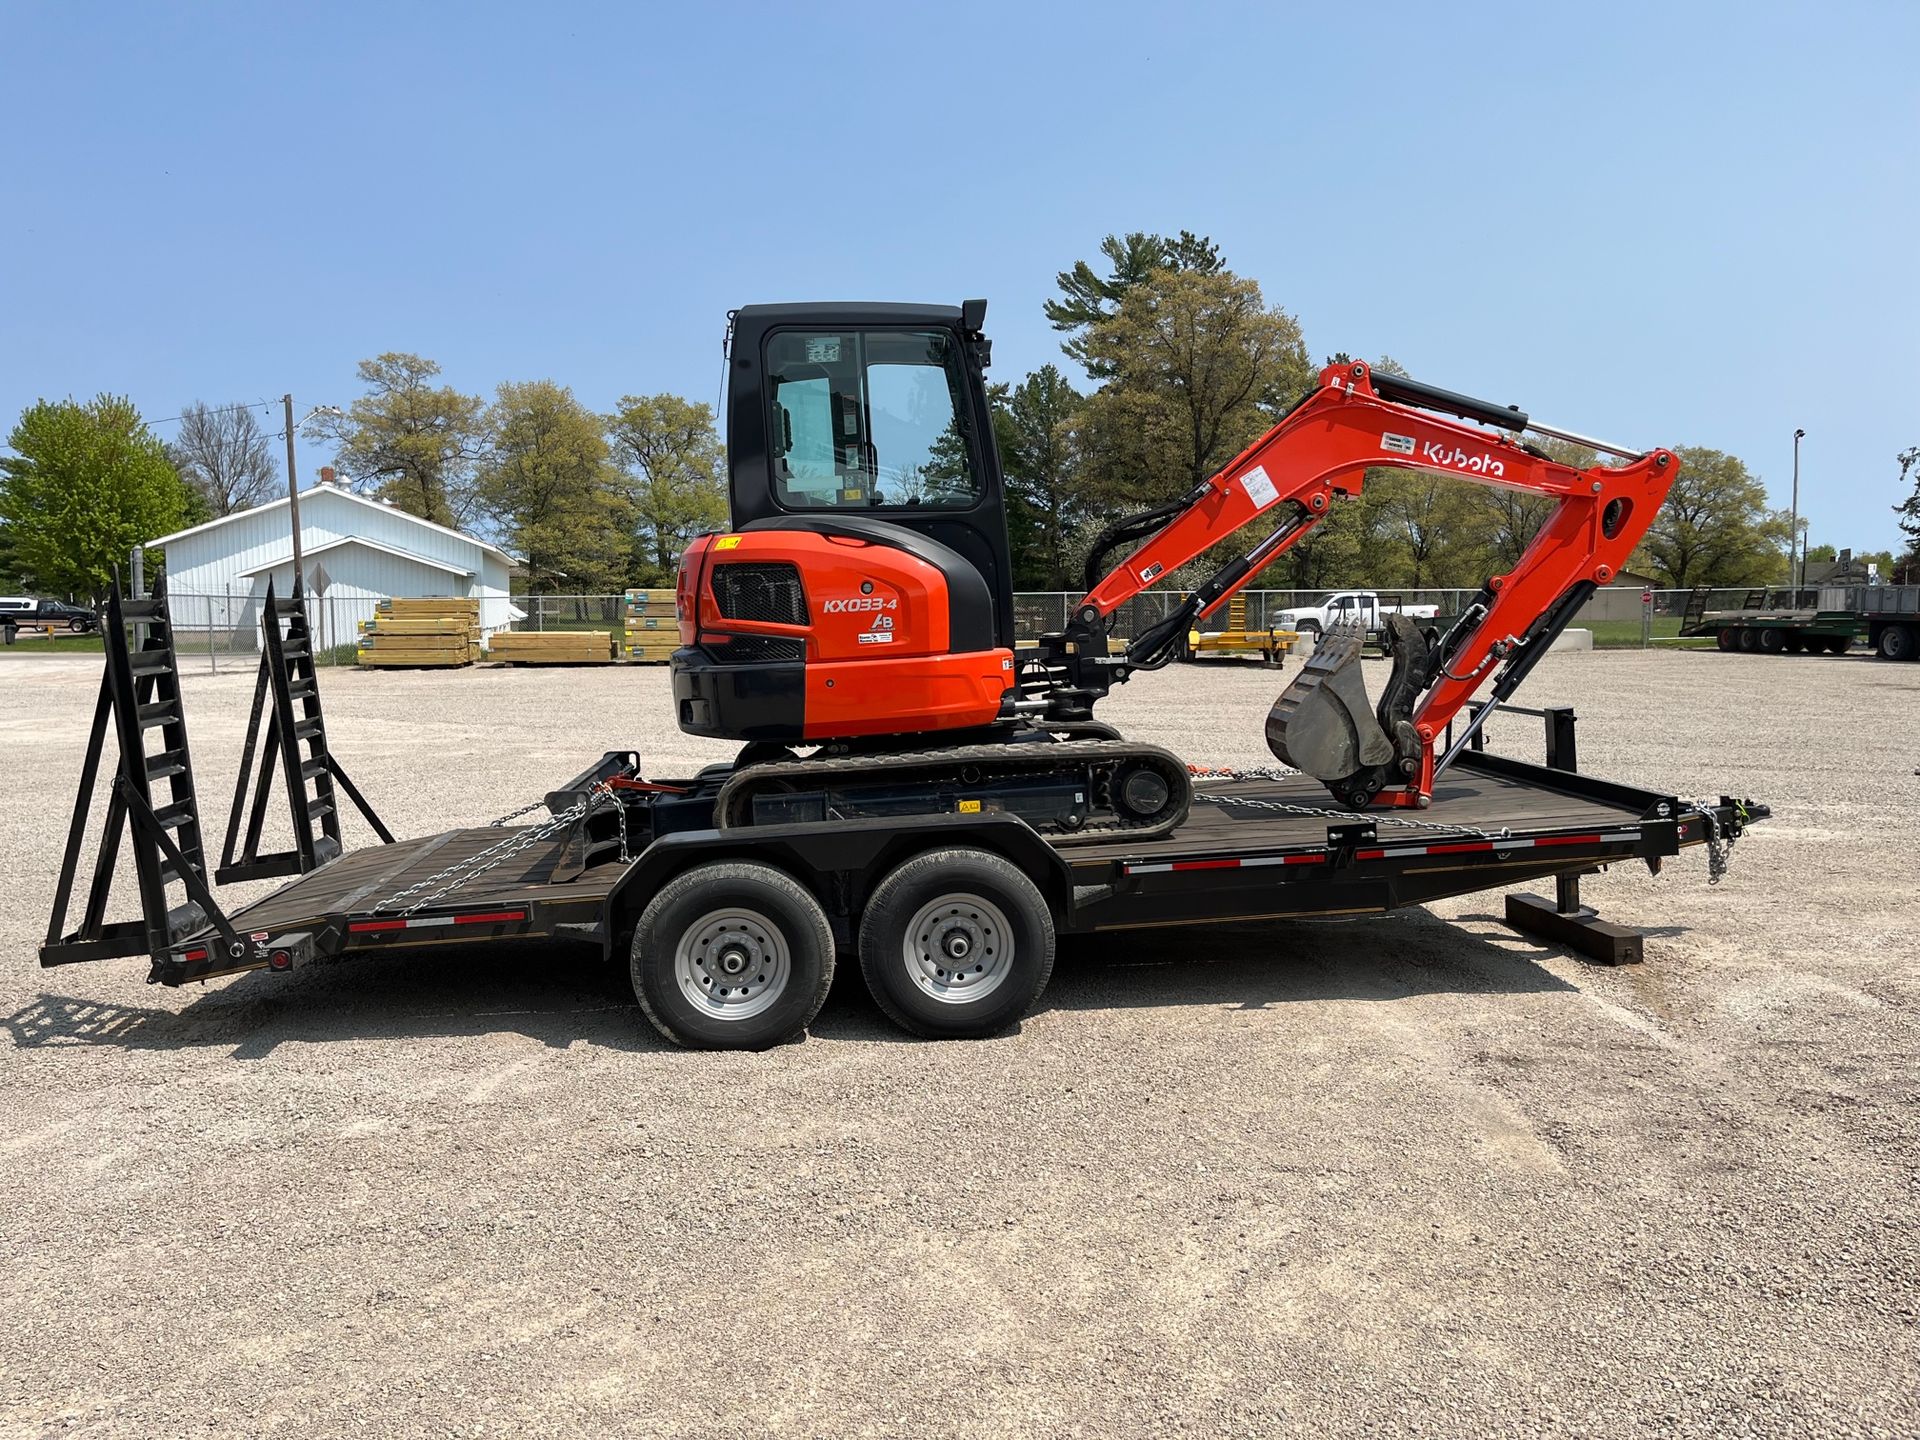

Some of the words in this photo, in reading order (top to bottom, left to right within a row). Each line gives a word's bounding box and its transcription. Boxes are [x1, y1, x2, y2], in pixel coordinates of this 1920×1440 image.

[1423, 441, 1504, 477] Kubota
[823, 598, 897, 613] KX033-4
[871, 613, 893, 628] AB
